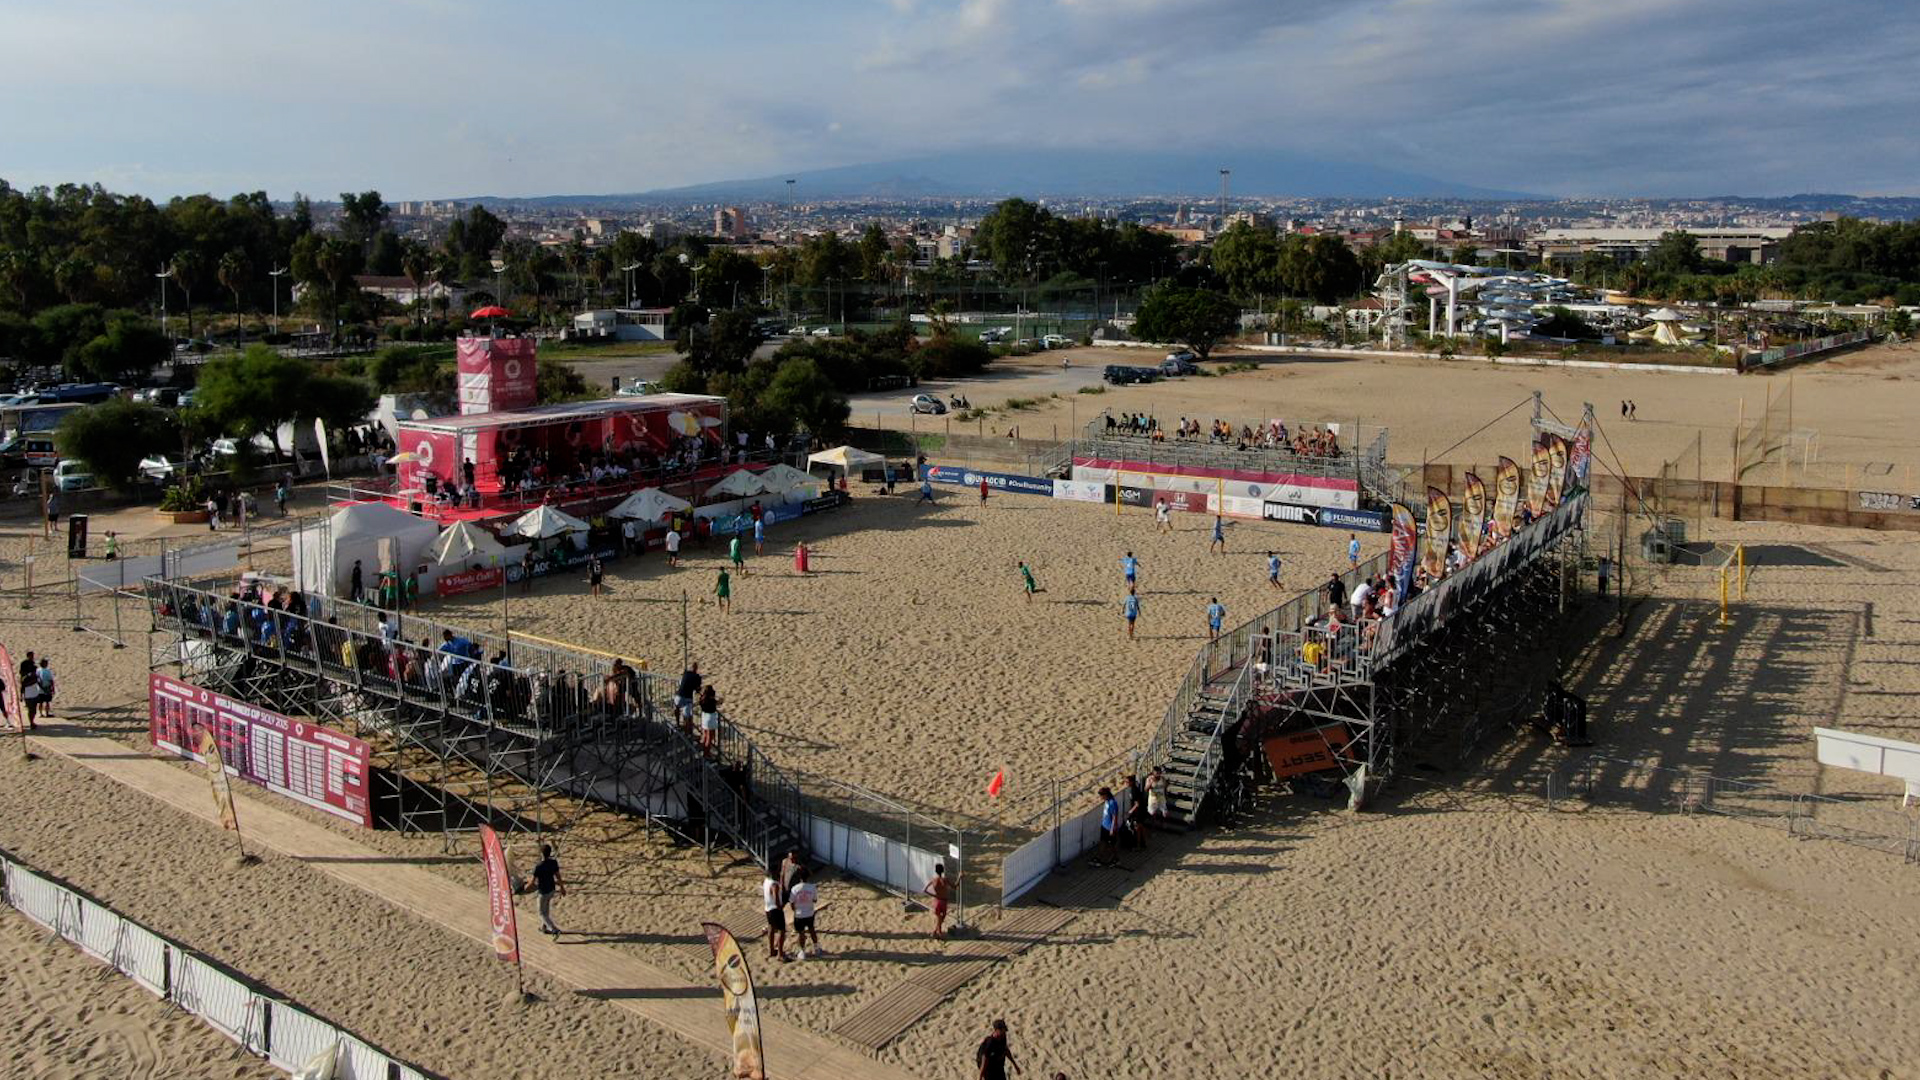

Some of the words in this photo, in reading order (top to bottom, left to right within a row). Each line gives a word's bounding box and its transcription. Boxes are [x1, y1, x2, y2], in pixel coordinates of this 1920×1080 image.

[1118, 489, 1141, 500] AGM
[1264, 503, 1305, 522] PUMA
[1281, 752, 1326, 768] SEAT
